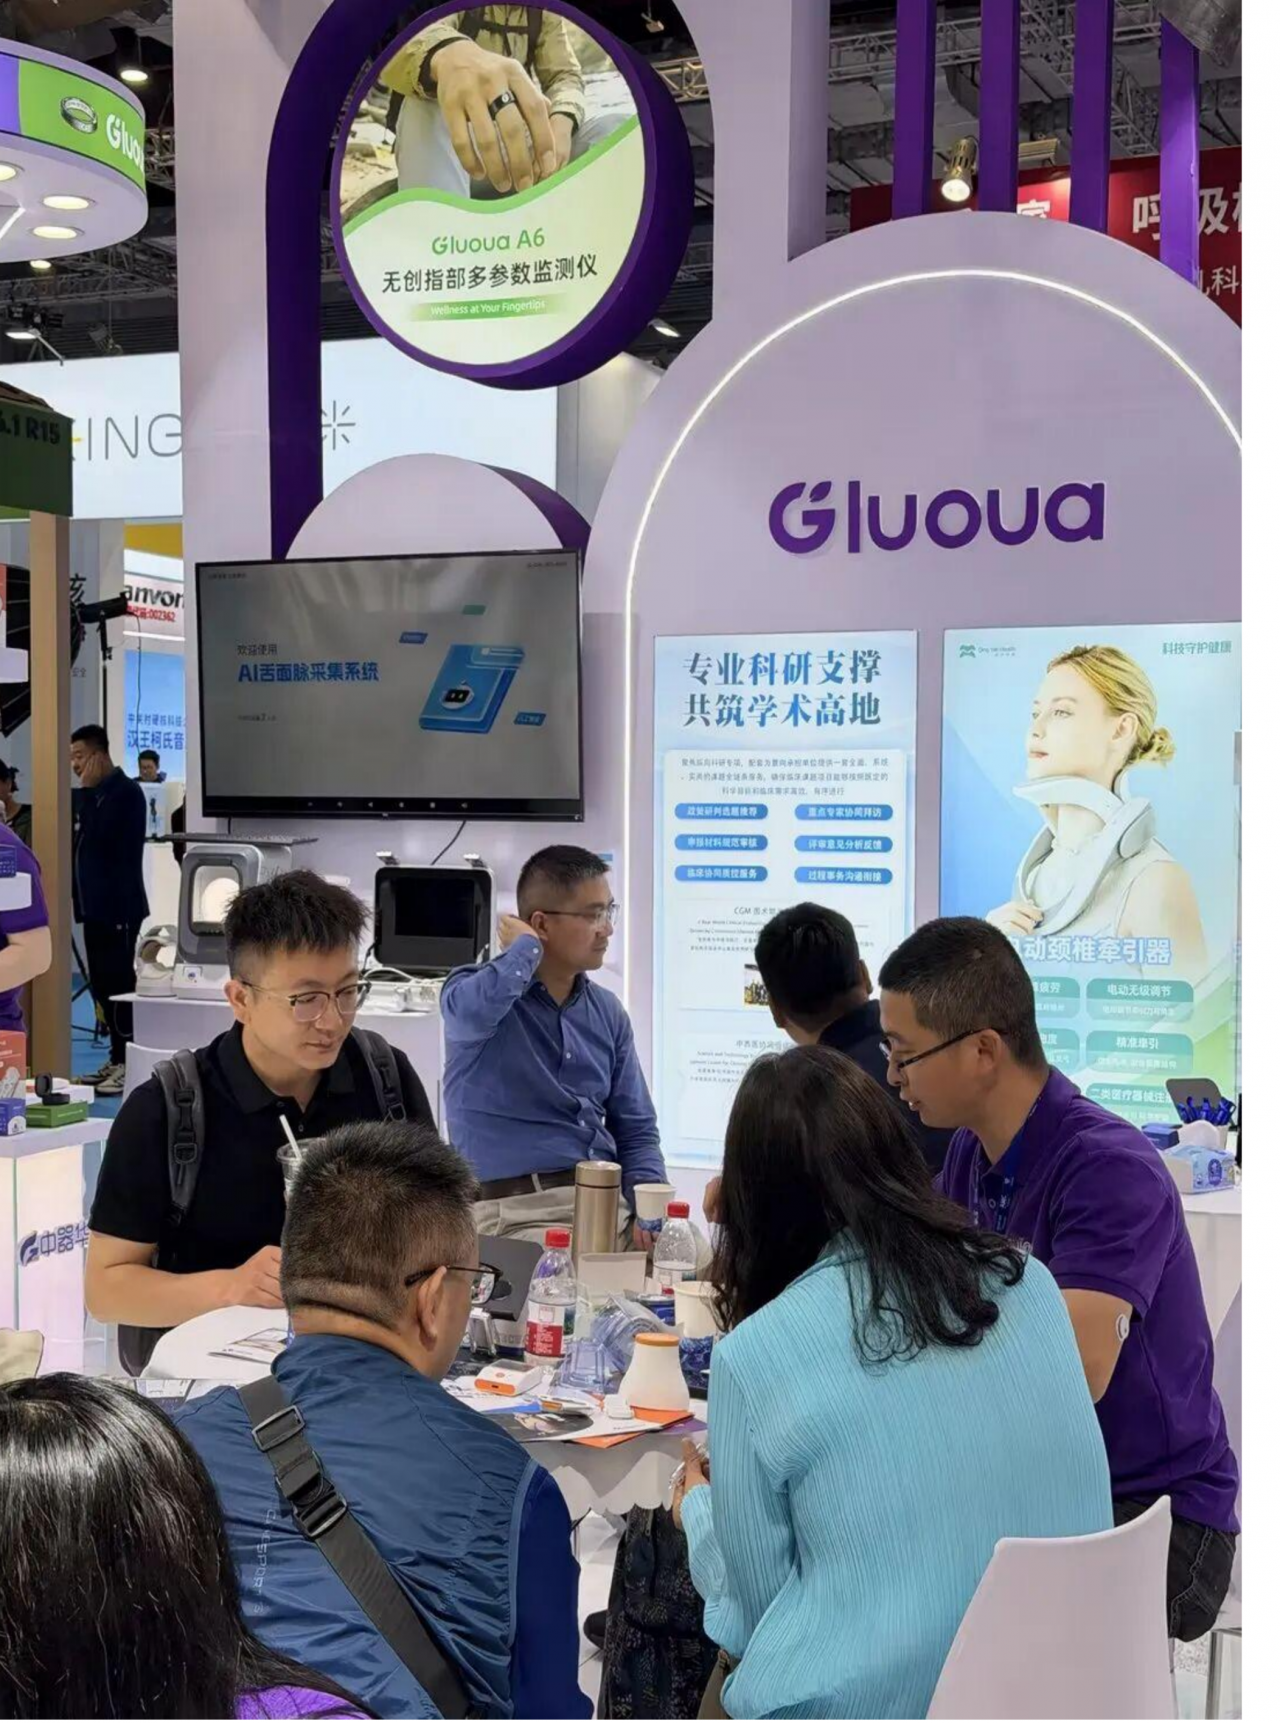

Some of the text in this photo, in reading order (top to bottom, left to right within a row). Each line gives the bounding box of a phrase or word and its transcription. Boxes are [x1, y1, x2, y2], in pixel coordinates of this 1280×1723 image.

[431, 227, 546, 256] Gluoua A6
[382, 253, 598, 294] 无创指部多参数监测仪
[430, 299, 546, 316] Wellness at Your Fingertips
[26, 416, 60, 445] R15
[71, 413, 183, 462] ING
[768, 479, 1105, 555] Gluoua
[237, 643, 278, 656] 欢迎使用
[238, 662, 379, 683] AI舌面脉采集系统
[683, 650, 881, 686] 专业科研支撑
[683, 692, 881, 727] 共筑学术高地
[1107, 984, 1172, 997] 电动无级调节
